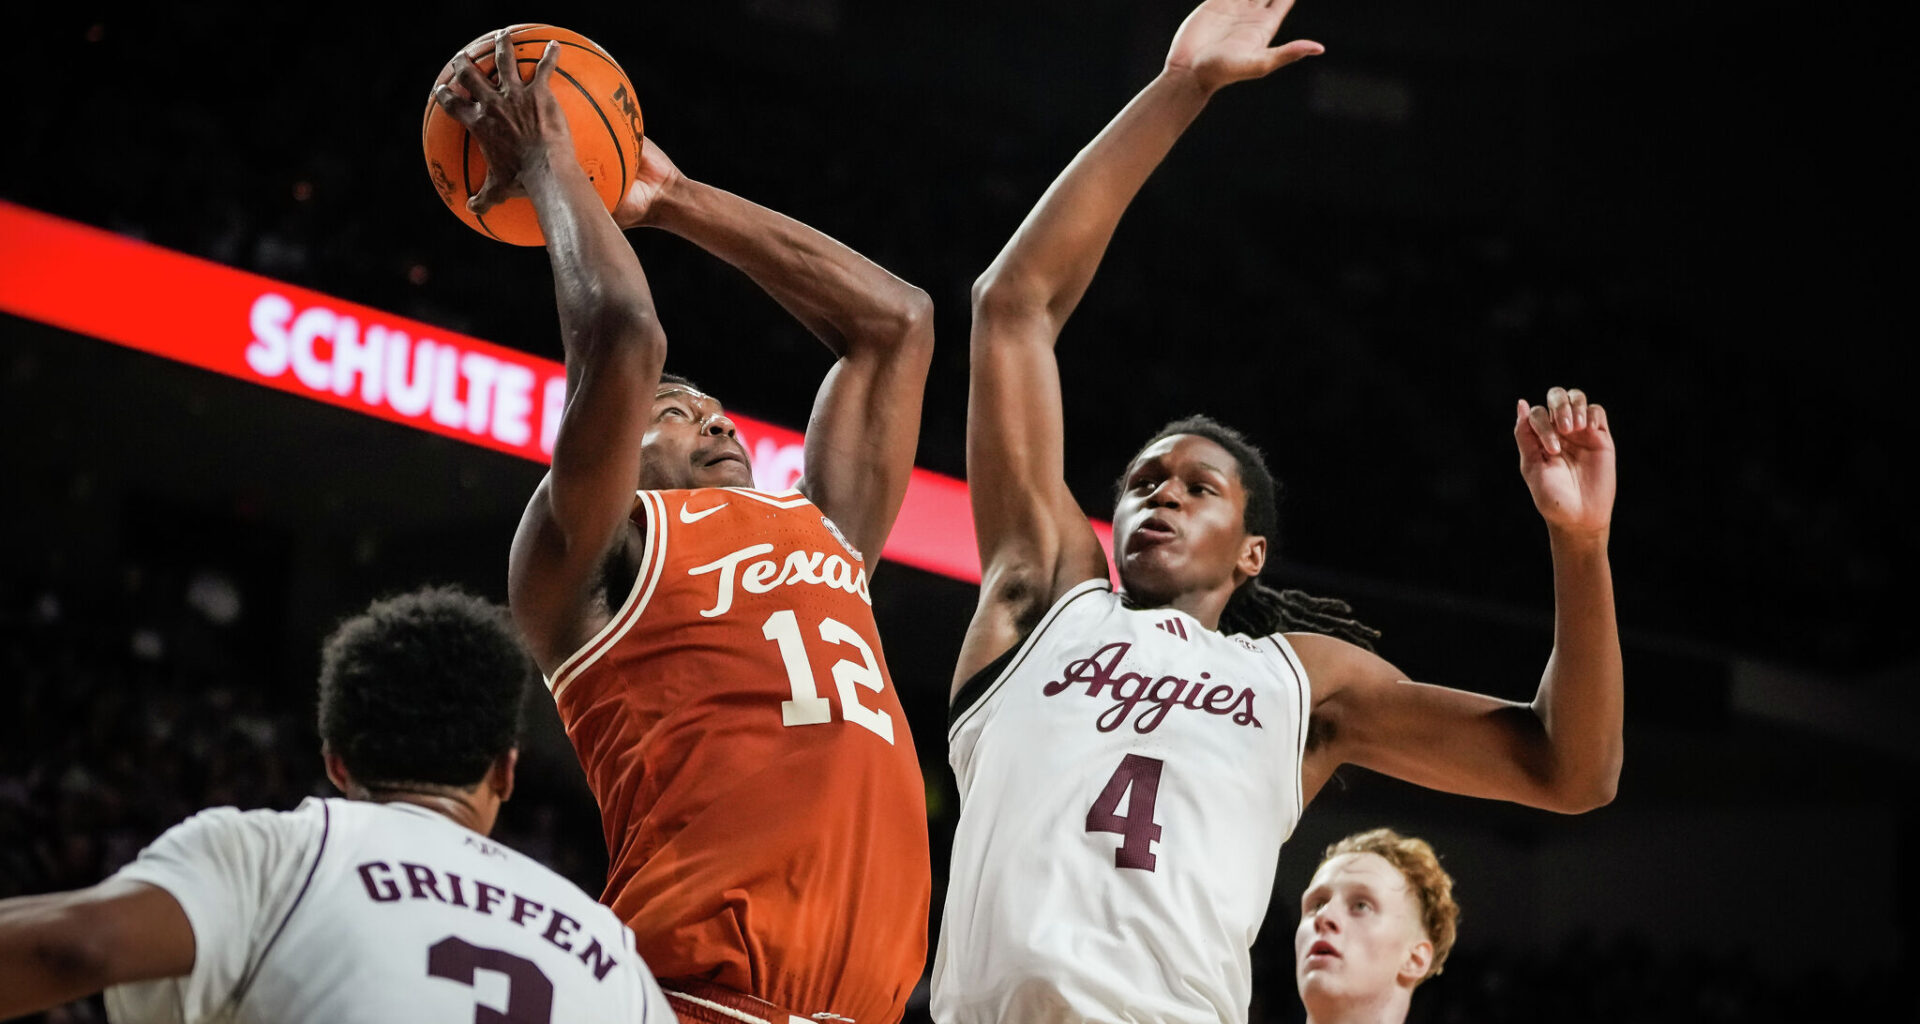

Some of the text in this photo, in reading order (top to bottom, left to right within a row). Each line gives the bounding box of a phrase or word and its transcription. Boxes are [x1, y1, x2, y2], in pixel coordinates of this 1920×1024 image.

[246, 293, 535, 447] SCHULTE
[762, 609, 895, 746] 12
[1043, 642, 1263, 734] Aggies
[1085, 753, 1164, 873] 4
[357, 861, 617, 983] GRIFFEN
